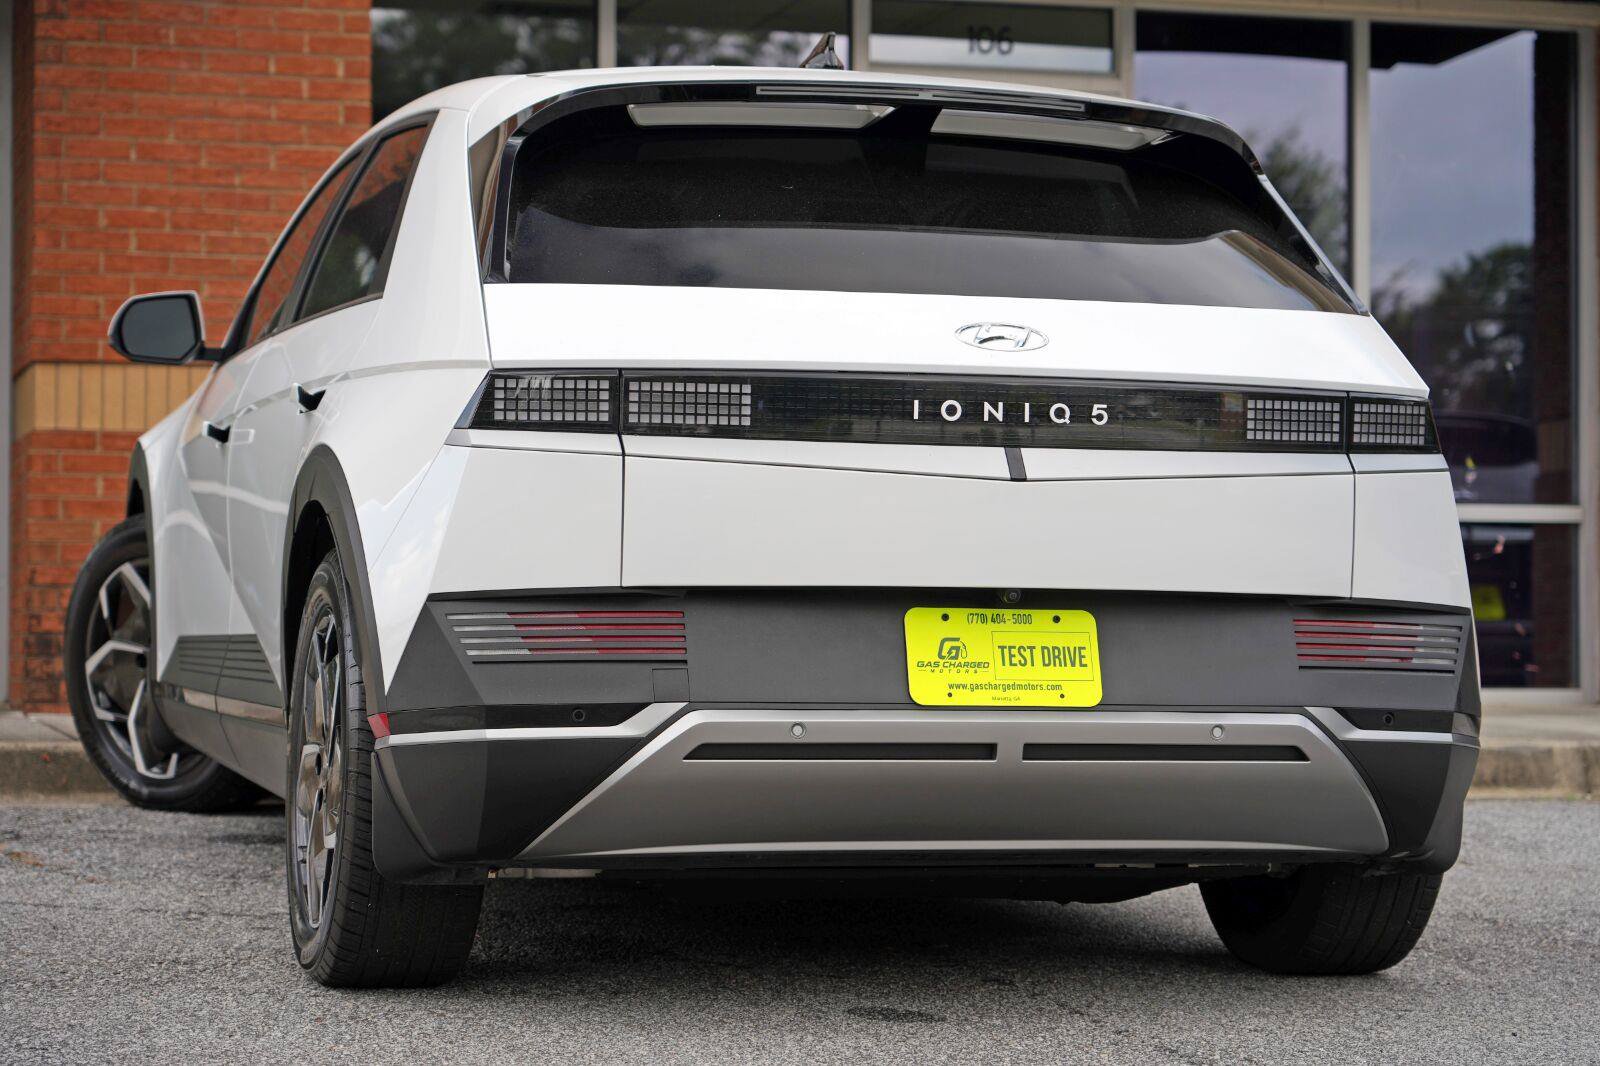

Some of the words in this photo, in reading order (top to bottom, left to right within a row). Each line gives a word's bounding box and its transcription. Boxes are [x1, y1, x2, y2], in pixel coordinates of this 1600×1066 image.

[968, 25, 1012, 55] 106
[913, 399, 1071, 424] IONIQ
[1091, 403, 1109, 426] 5
[967, 613, 988, 625] (770)
[916, 661, 941, 669] GAS
[942, 661, 990, 669] CHARGED
[997, 645, 1036, 667] TEST
[1041, 645, 1088, 668] DRIVE
[948, 682, 1063, 693] www.gaschargedmotors.com
